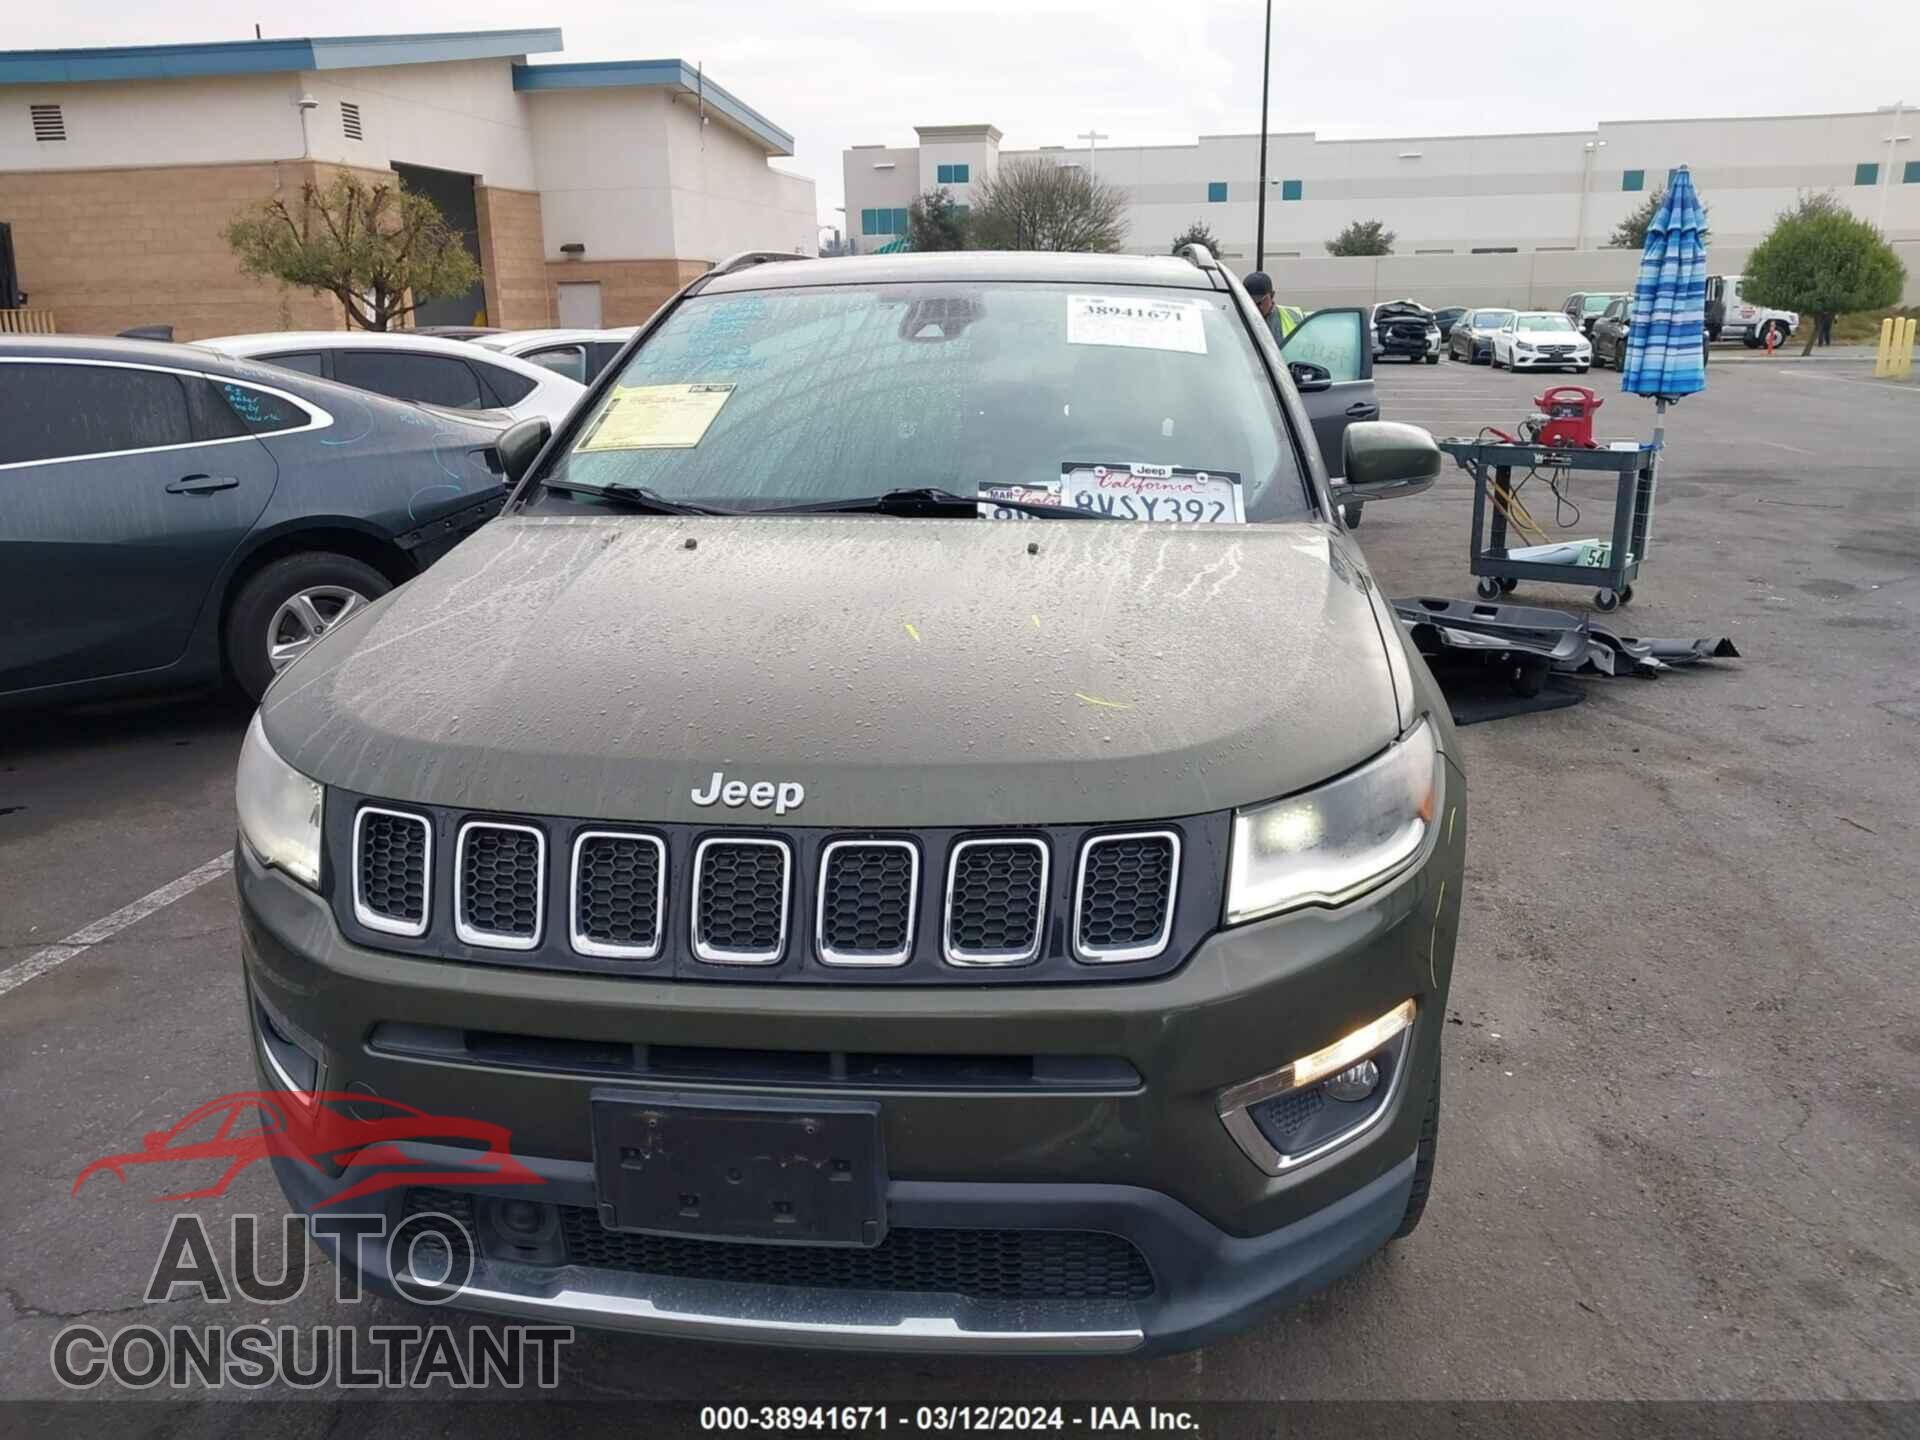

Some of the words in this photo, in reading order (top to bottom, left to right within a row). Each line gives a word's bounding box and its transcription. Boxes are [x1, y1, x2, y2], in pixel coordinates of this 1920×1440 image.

[1136, 465, 1167, 477] Jeep
[1098, 473, 1203, 495] California
[1587, 549, 1606, 567] 54
[691, 771, 805, 815] Jeep
